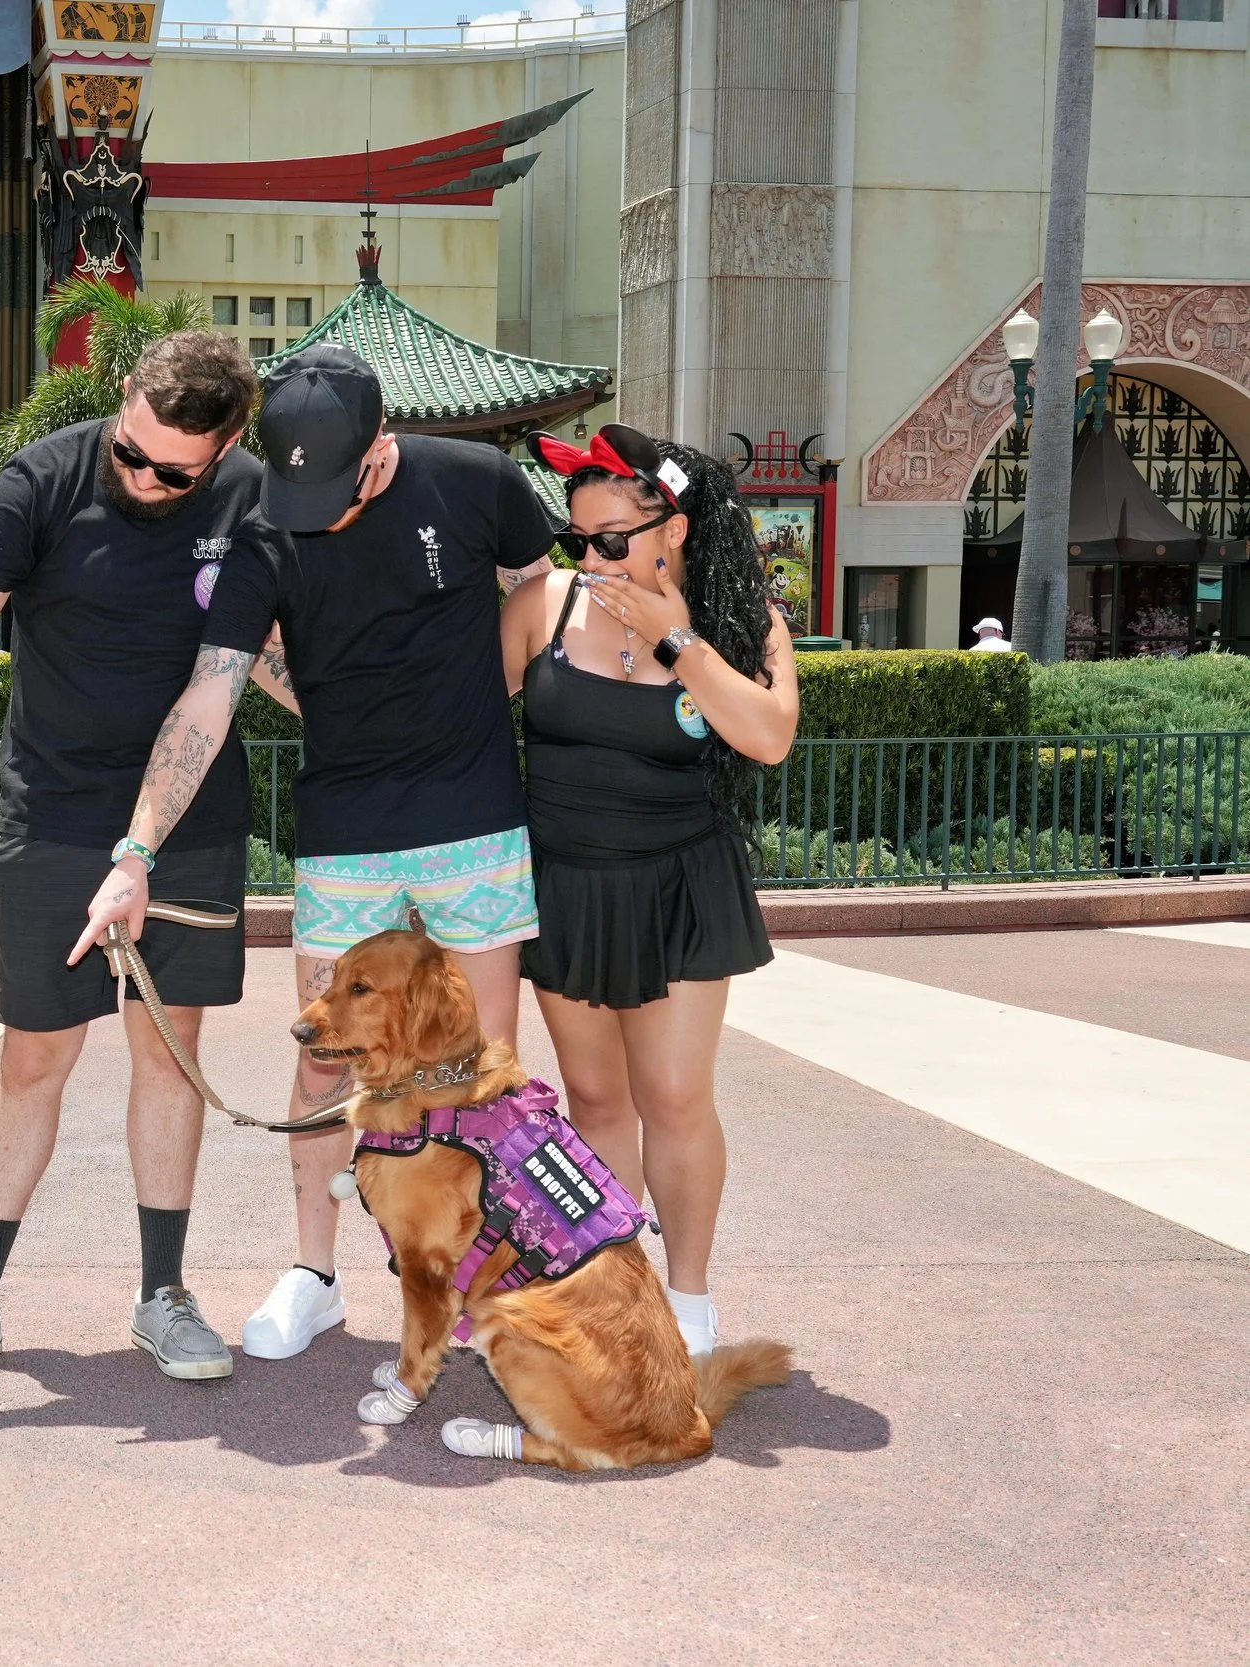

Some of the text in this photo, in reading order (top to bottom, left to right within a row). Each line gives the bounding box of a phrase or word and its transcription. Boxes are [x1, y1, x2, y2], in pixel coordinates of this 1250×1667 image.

[193, 548, 225, 559] UNIT
[525, 1156, 585, 1219] DO NOT PET
[544, 1142, 601, 1205] SERVICE DOG
